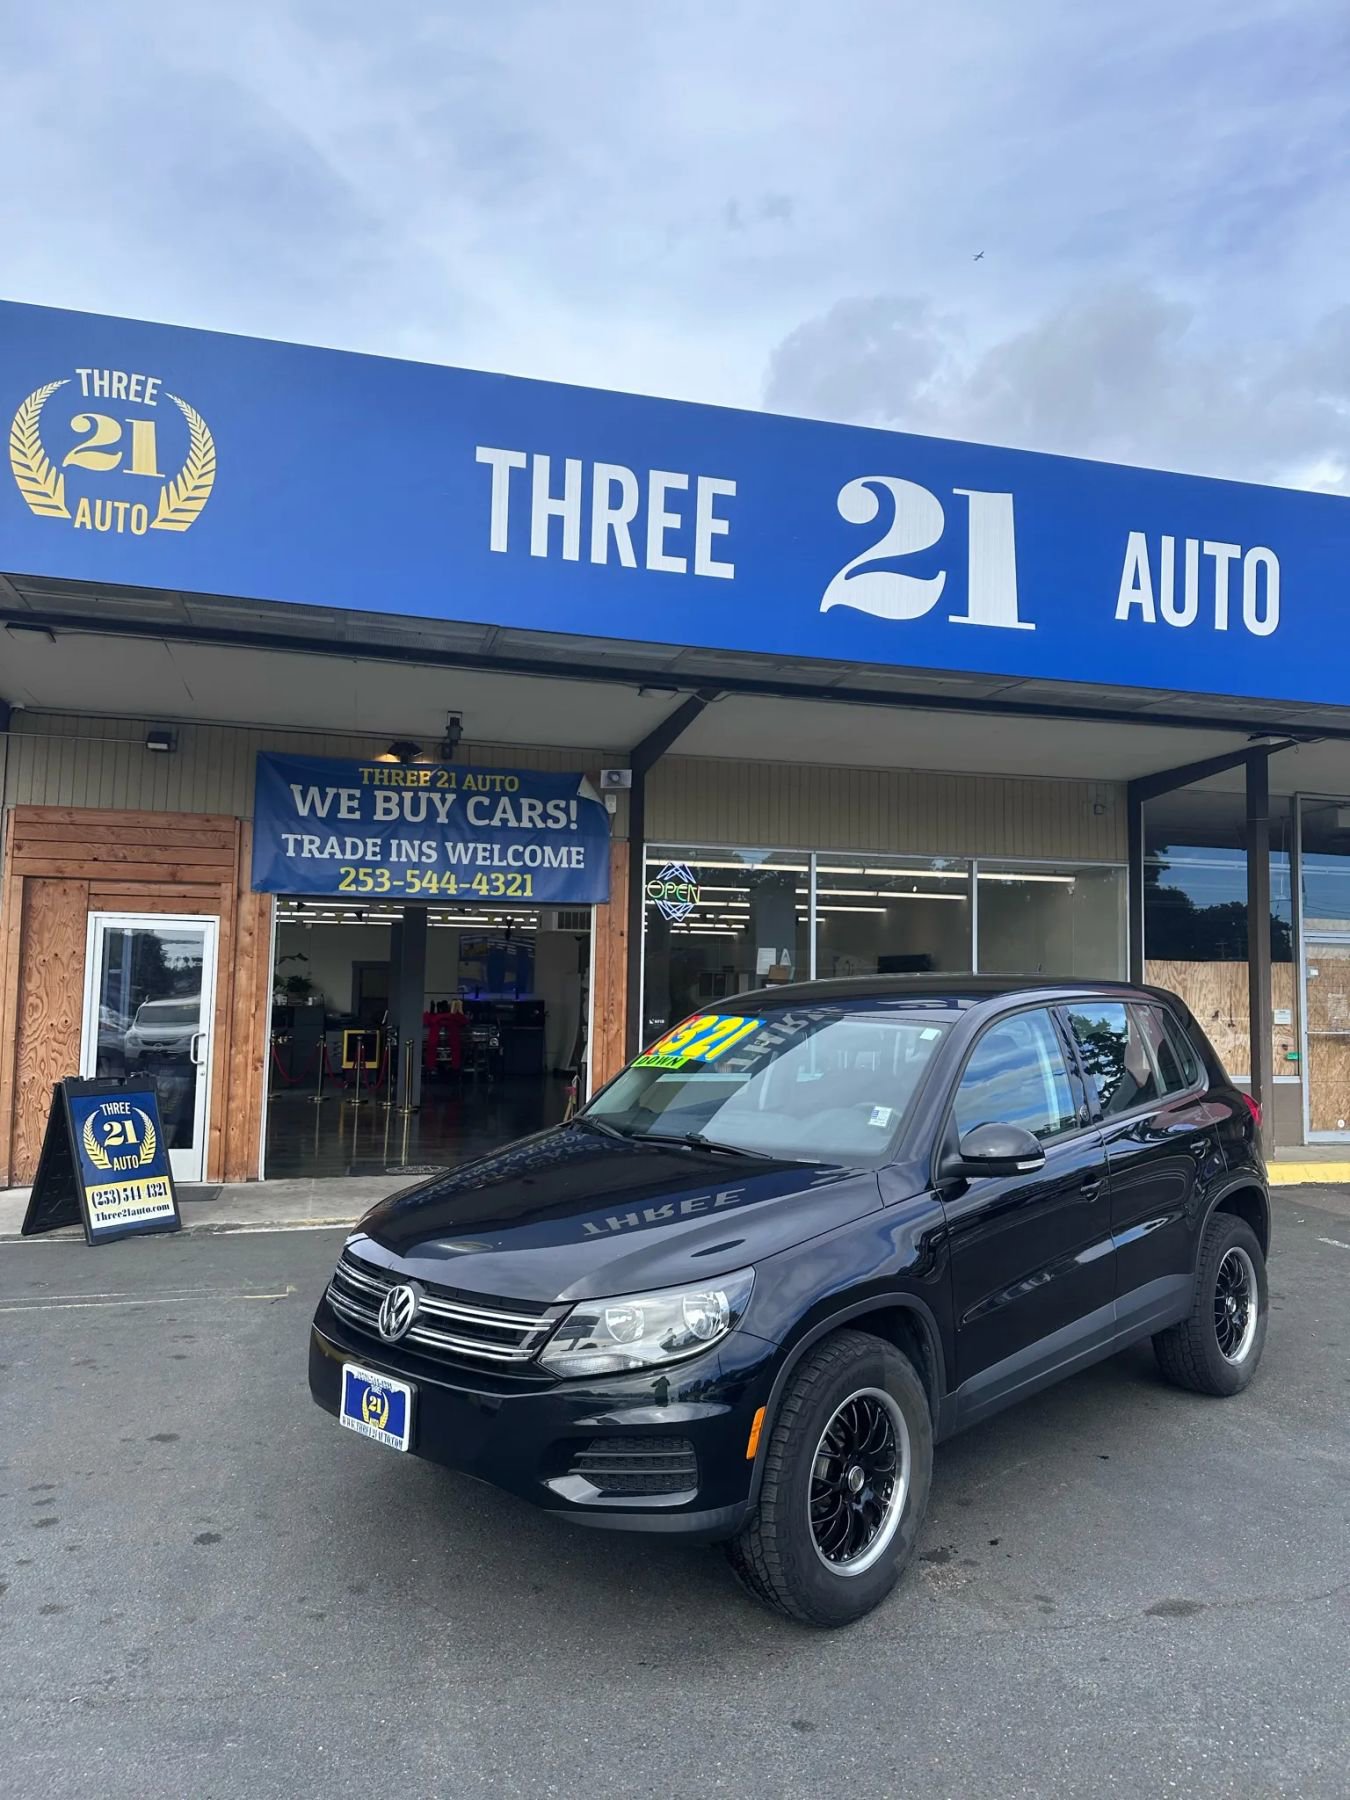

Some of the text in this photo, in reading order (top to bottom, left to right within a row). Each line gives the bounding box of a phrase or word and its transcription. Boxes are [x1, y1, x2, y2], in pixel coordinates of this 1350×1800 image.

[75, 368, 162, 406] THREE
[62, 413, 166, 478] 21
[74, 497, 149, 536] AUTO
[475, 446, 1280, 636] THREE 21 AUTO
[359, 767, 519, 792] THREE 21 AUTO
[290, 784, 578, 830] WE BUY CARS!
[281, 833, 585, 869] TRADE INS WELCOME
[338, 866, 533, 897] 253-544-4321
[647, 879, 701, 904] OPEN
[635, 1055, 685, 1067] DOWN
[100, 1102, 131, 1116] THREE
[103, 1119, 140, 1147] 21
[113, 1155, 139, 1171] AUTO
[91, 1187, 121, 1209] (253)
[94, 1203, 170, 1222] Three21auto.com
